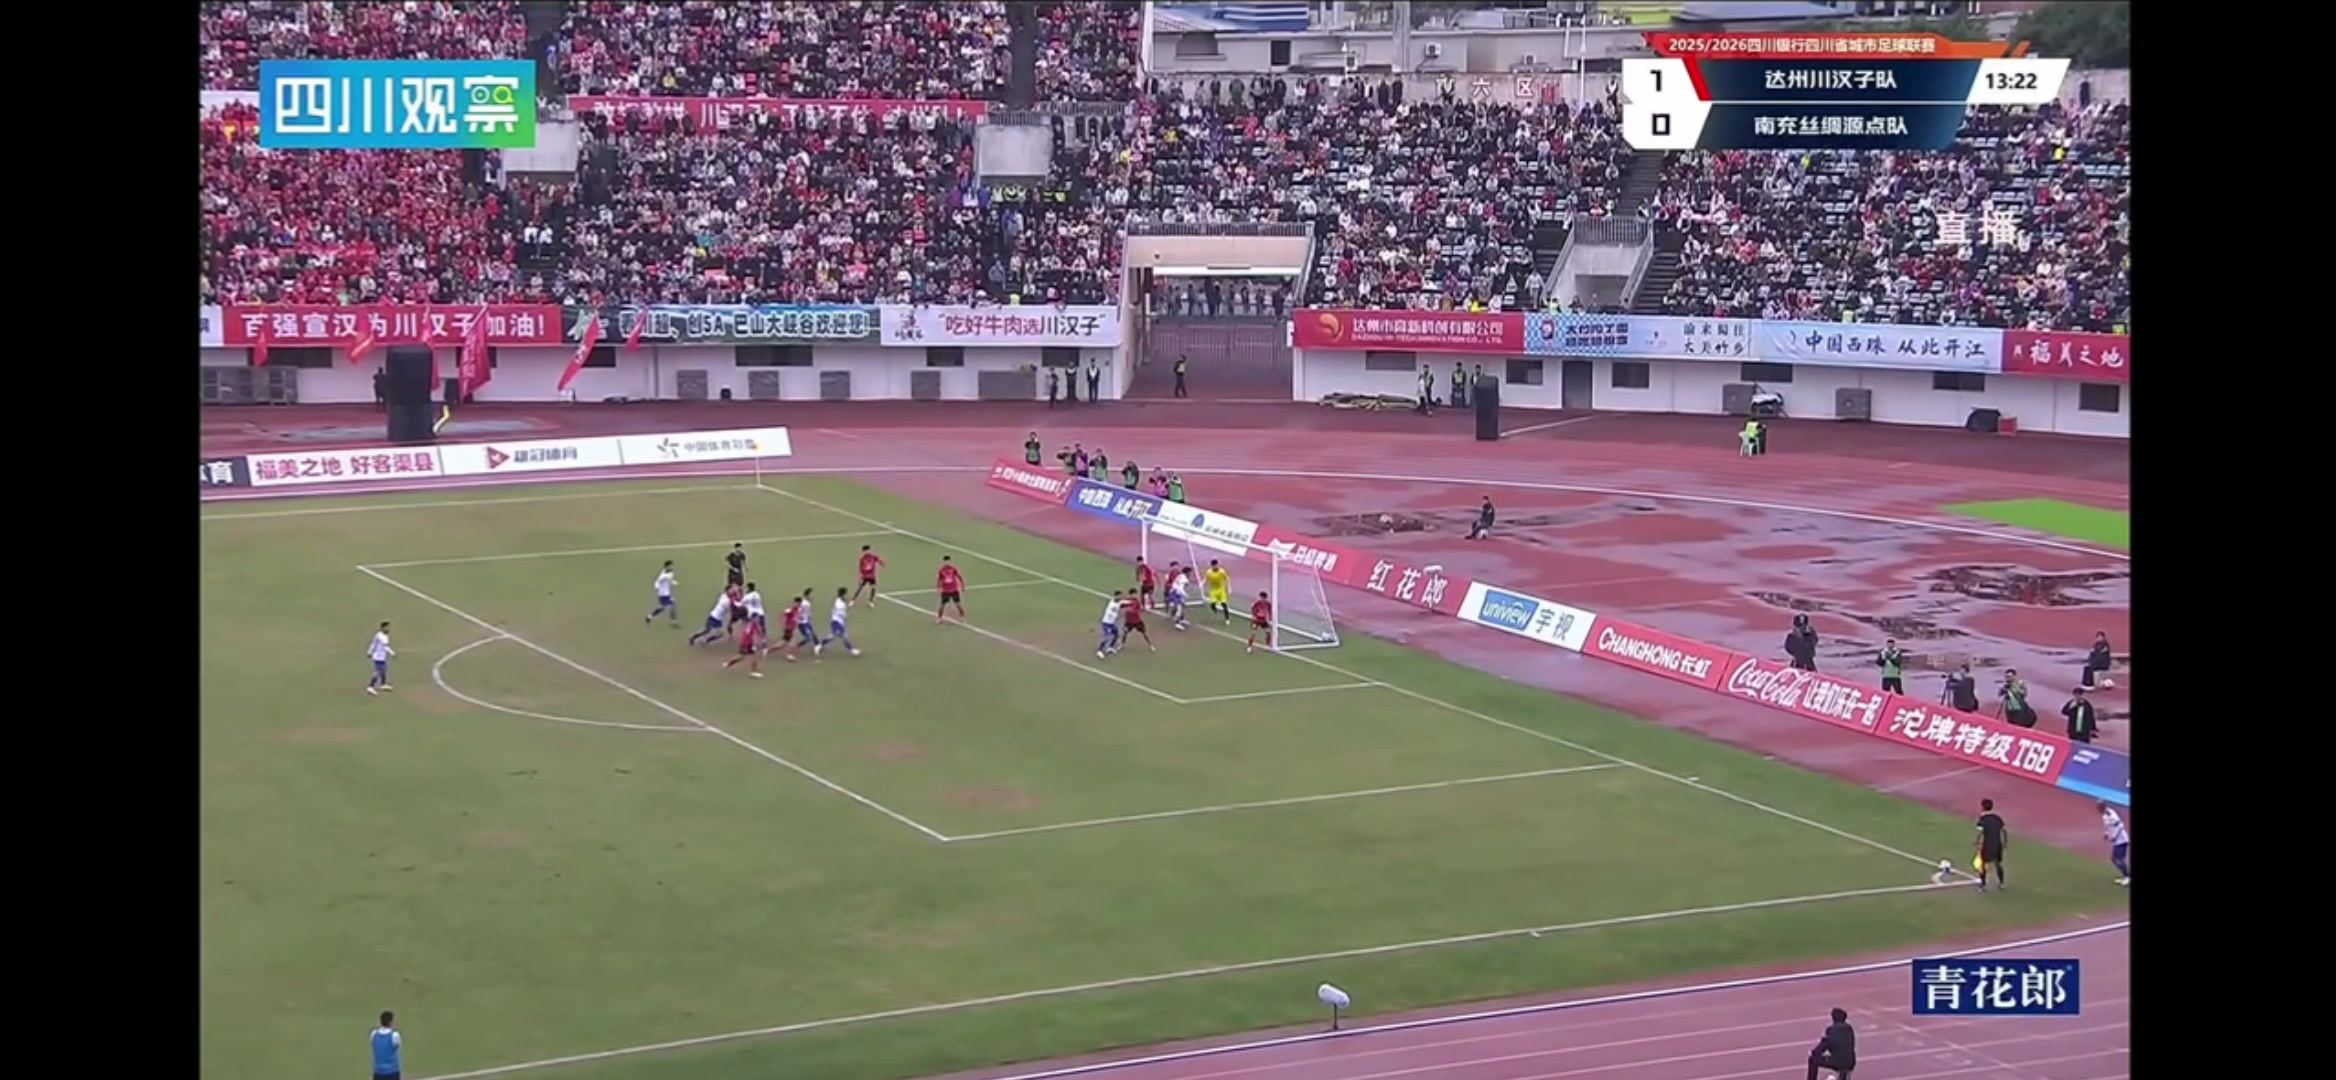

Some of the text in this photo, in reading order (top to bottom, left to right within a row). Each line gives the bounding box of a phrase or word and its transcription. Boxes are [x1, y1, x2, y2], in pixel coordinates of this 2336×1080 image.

[1897, 339, 1985, 358] 从此开江
[200, 461, 233, 484] 育
[257, 452, 433, 480] 福美之地 好客渠县
[1484, 600, 1574, 641] uniview 宇视
[1599, 627, 1712, 679] CHANGHONG 长虹
